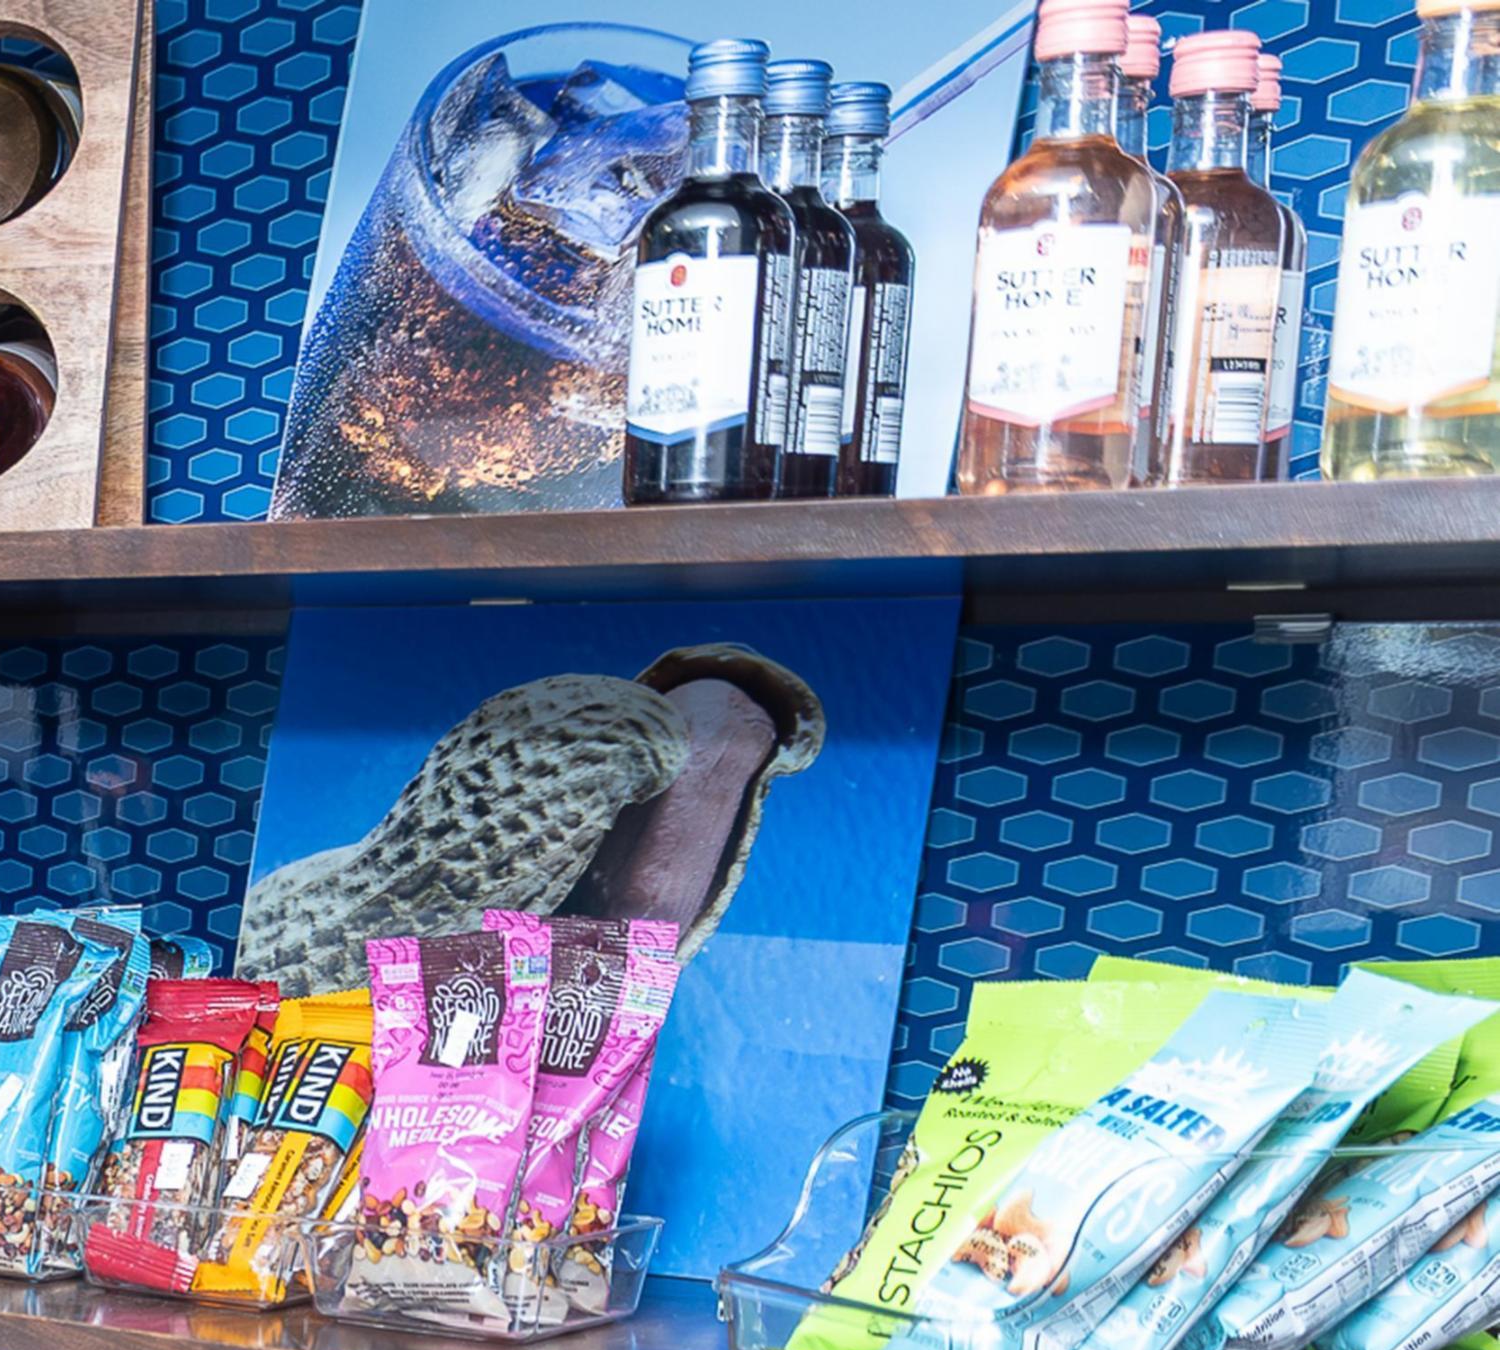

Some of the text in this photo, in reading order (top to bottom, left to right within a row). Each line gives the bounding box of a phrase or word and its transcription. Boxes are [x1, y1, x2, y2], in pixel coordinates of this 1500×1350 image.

[1360, 241, 1467, 269] SUTTR
[140, 1051, 184, 1128] KIND
[293, 1045, 350, 1123] KIND
